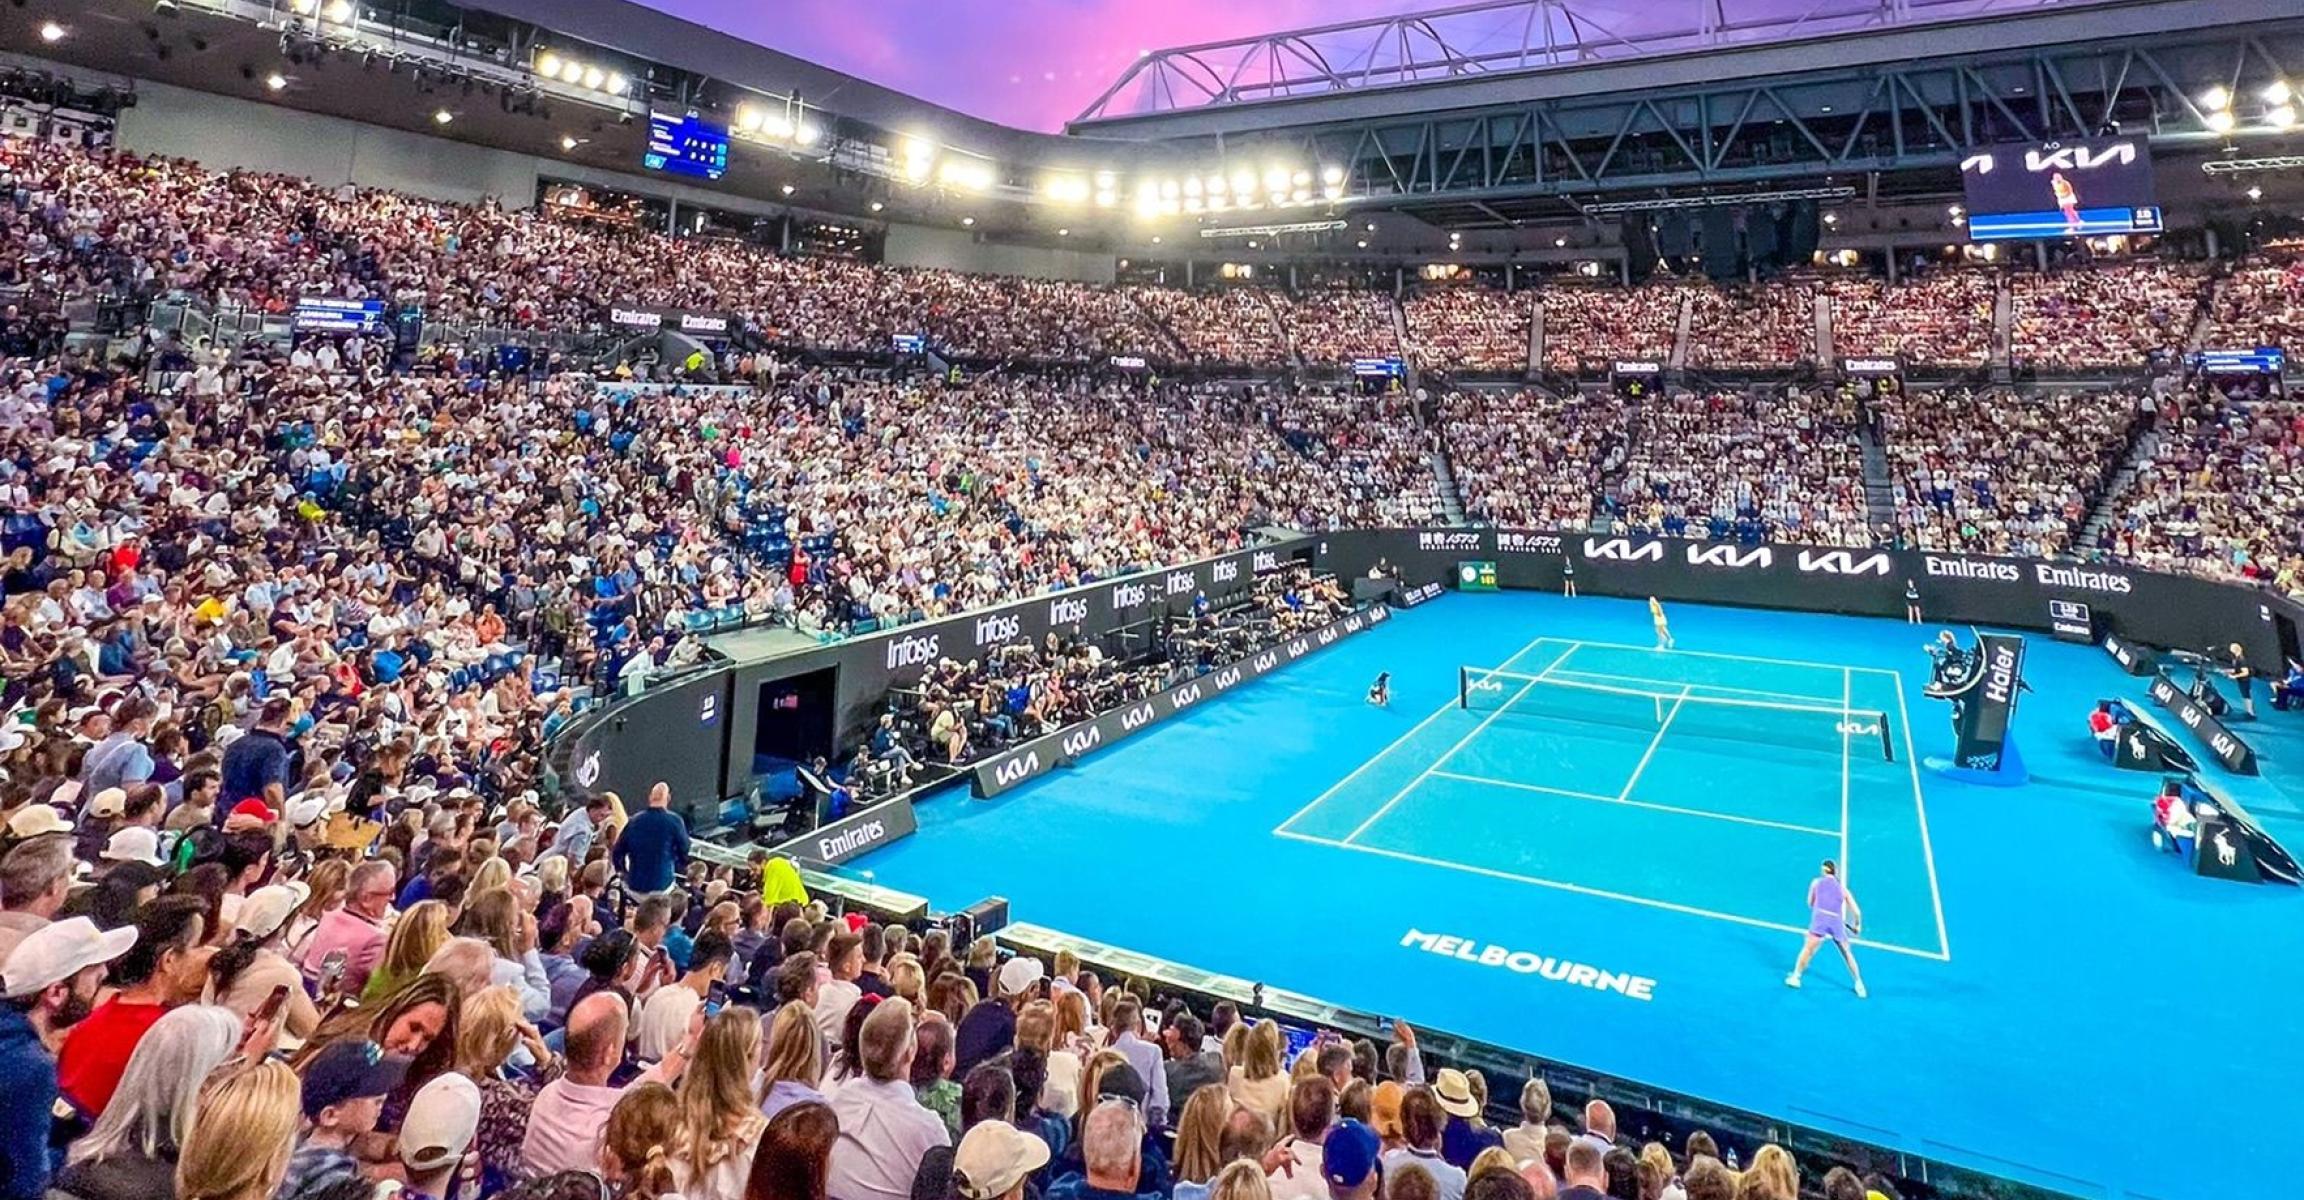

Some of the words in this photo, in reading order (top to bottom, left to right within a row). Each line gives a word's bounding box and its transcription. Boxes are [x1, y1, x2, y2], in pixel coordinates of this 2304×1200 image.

[2025, 143, 2135, 171] KIA
[611, 308, 662, 326] Emirates
[681, 314, 727, 331] Emirates
[1583, 537, 1664, 562] KIA
[1687, 543, 1772, 568] KIA
[1799, 550, 1890, 575] KIA
[1925, 556, 2020, 581] Emirates
[2036, 564, 2132, 592] Emirates
[1112, 583, 1146, 609] Infosys
[1050, 597, 1087, 626] Infosys
[975, 614, 1020, 645] Infosys
[887, 634, 940, 669] Infosys
[1986, 645, 2015, 703] Haier
[819, 820, 885, 861] Emirates
[1400, 928, 1657, 1001] MELBOURNE
